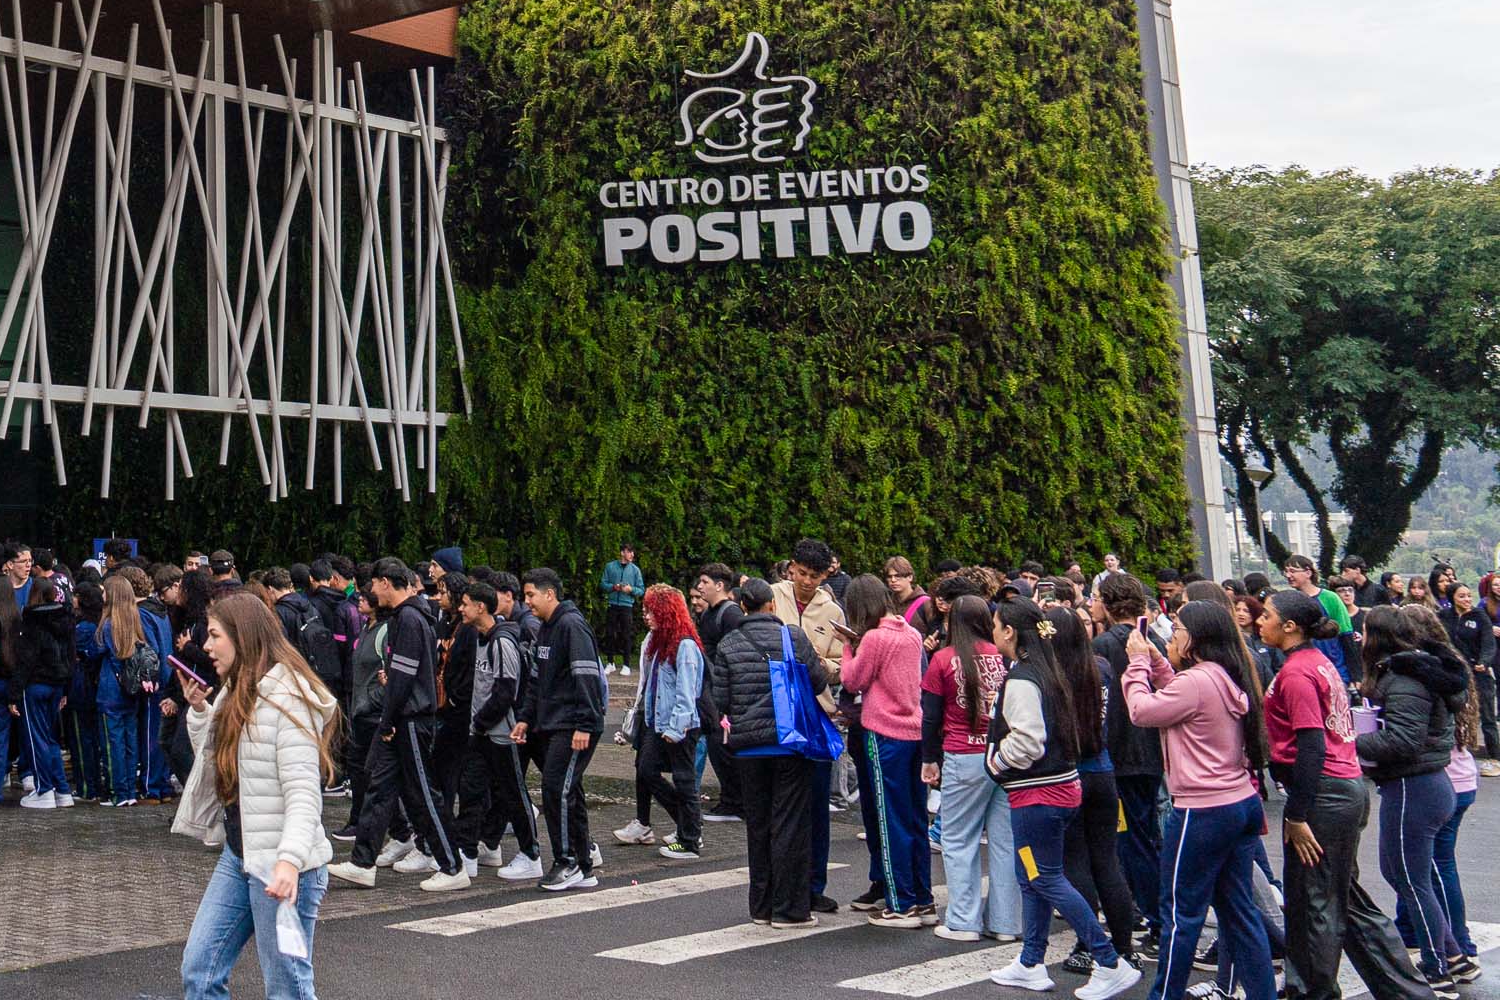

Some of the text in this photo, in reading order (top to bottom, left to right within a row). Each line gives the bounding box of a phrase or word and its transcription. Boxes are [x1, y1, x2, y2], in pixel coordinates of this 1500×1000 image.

[599, 164, 930, 208] CENTRO DE EVENTOS
[602, 200, 933, 266] POSITIVO
